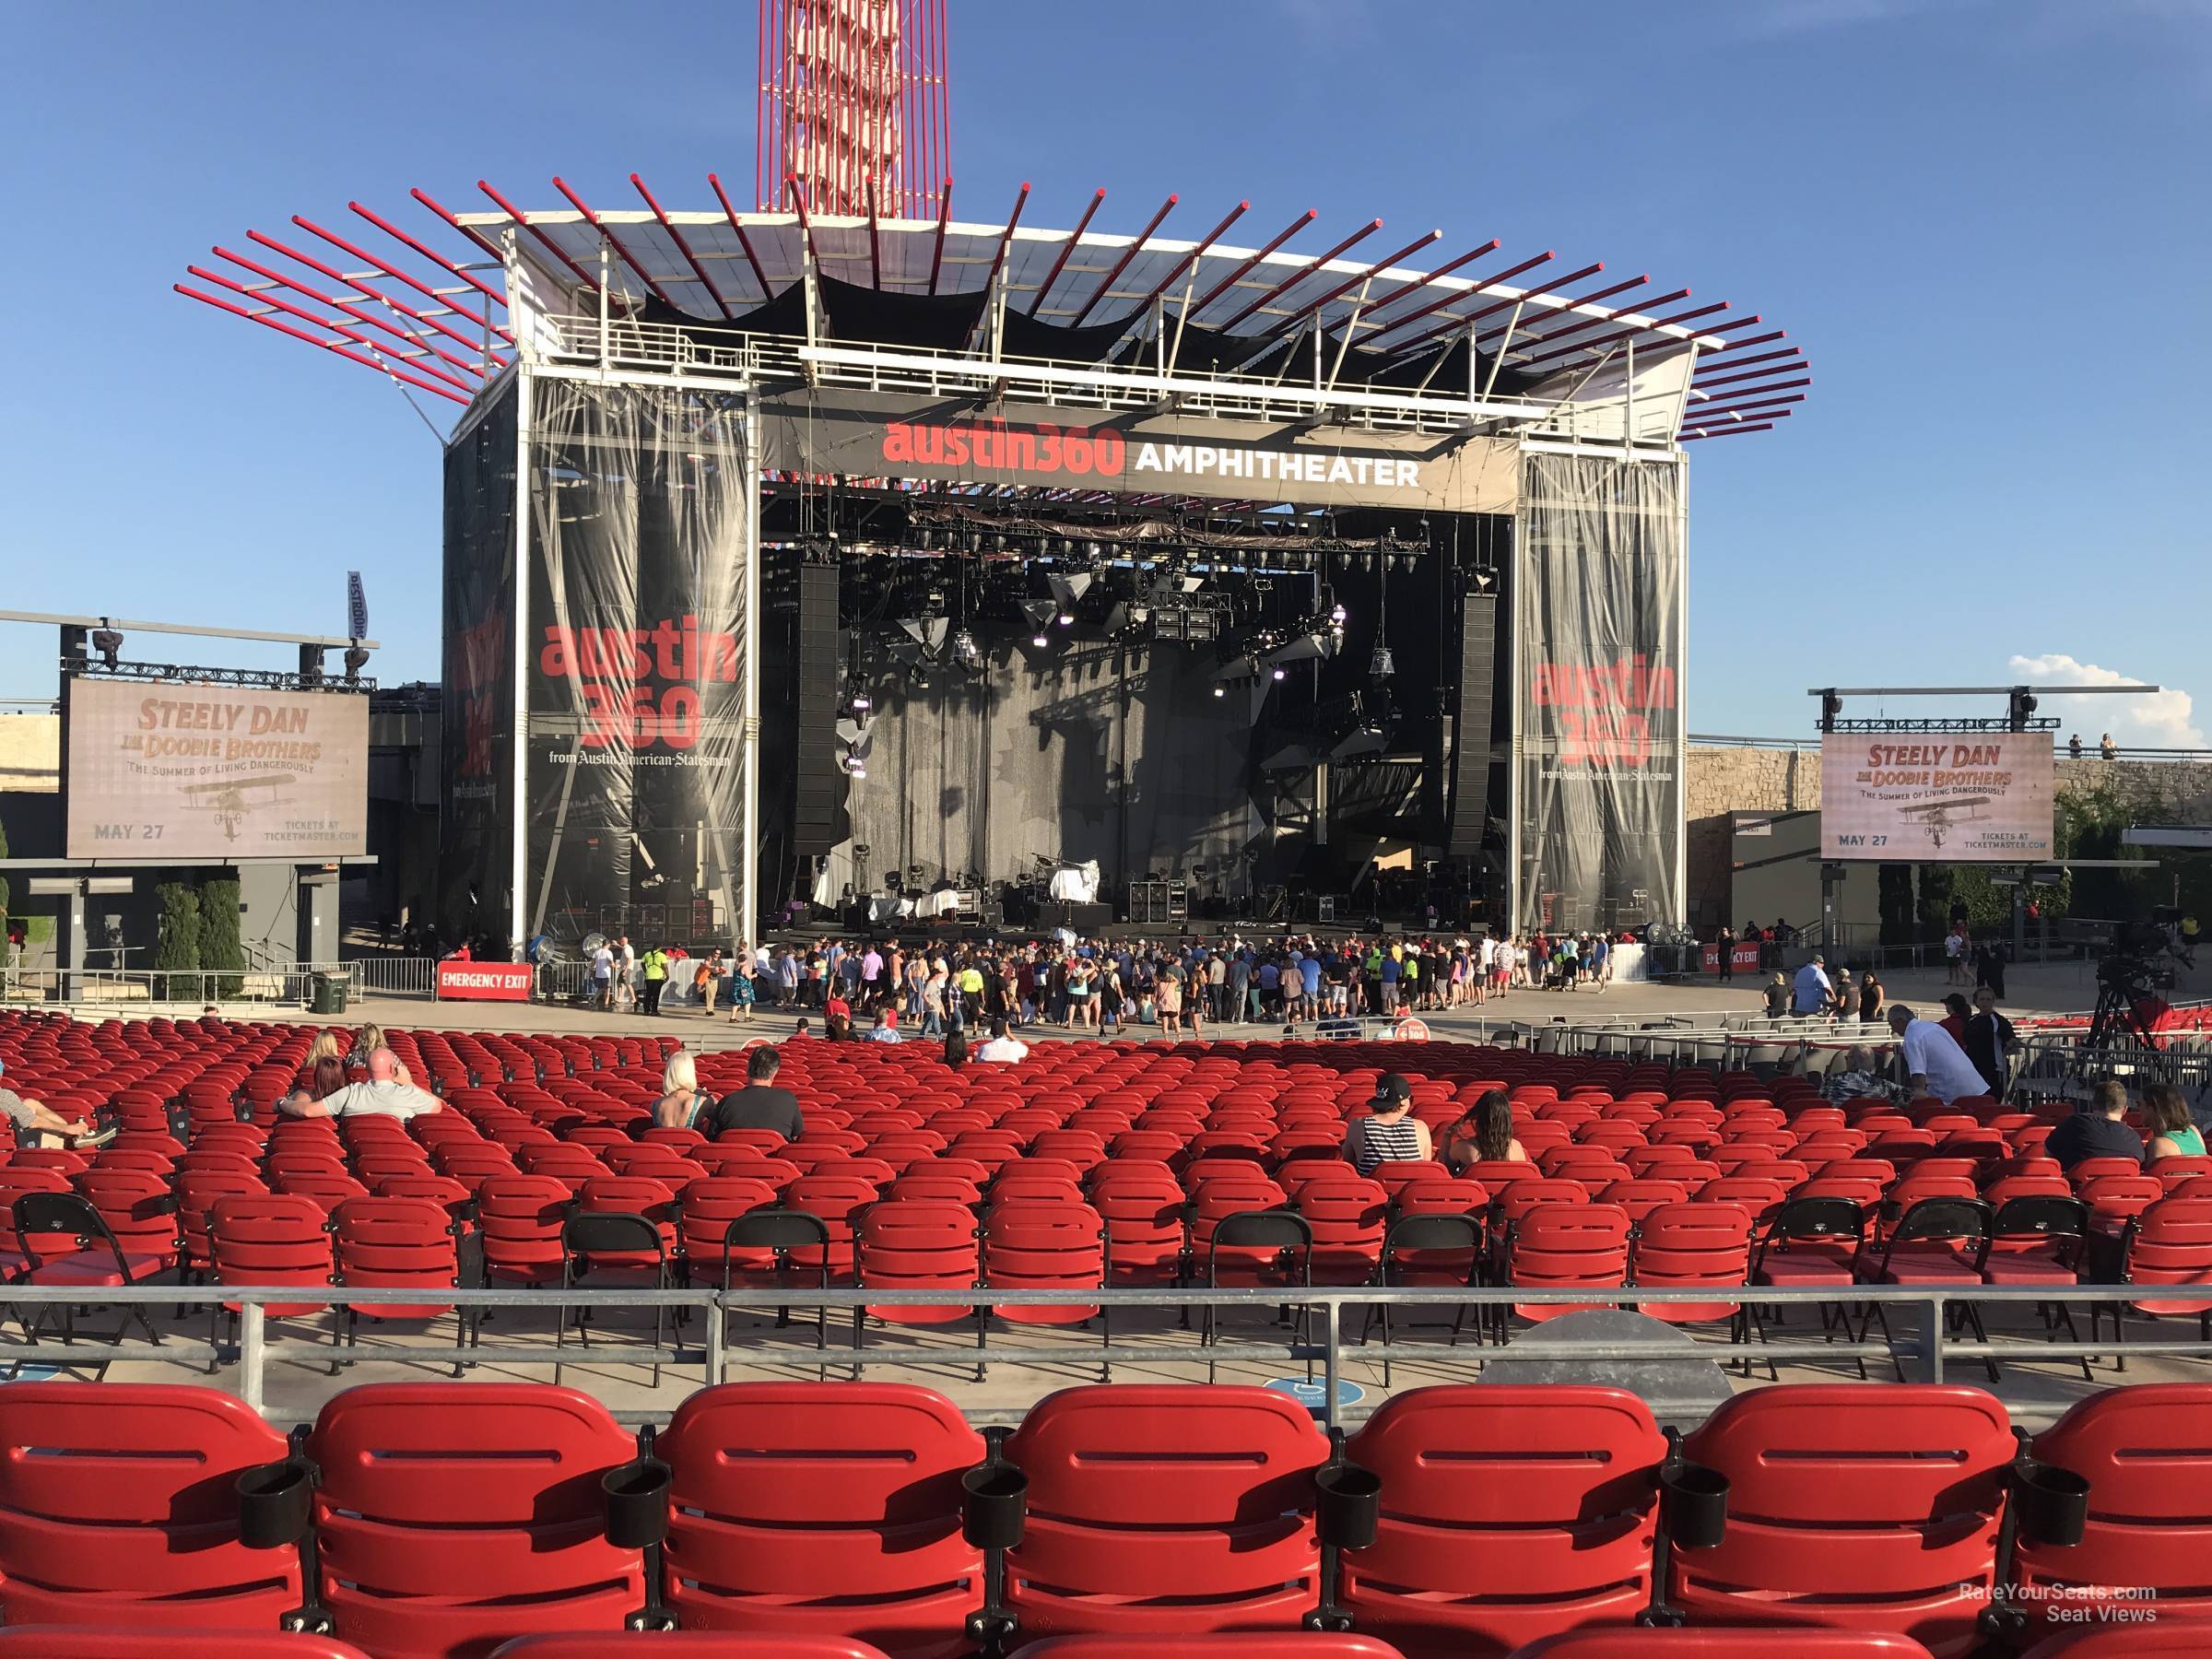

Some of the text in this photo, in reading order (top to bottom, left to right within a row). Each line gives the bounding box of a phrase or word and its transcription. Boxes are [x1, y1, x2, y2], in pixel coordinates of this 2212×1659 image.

[883, 417, 1419, 488] austin360 AMPHITHEATER
[540, 615, 737, 682] austin
[1531, 653, 1675, 709] austin
[138, 698, 310, 735] STEELY DAN
[580, 684, 701, 748] 360
[1561, 711, 1651, 766] 360
[144, 735, 221, 758] DOOBIE
[225, 737, 322, 760] BROTHERS
[1867, 744, 2001, 768] STEELY DAN
[549, 751, 576, 764] from
[577, 750, 616, 766] Austin
[127, 760, 314, 776] THE SUMMER OF LIVING DANGEROUSLY
[1539, 768, 1561, 780] from
[1873, 771, 1929, 788] DOOBIE
[1933, 771, 2013, 788] BROTHERS
[1860, 789, 1877, 799] THE
[1924, 789, 1950, 799] LIVING
[1952, 786, 2006, 796] DANGEROUSLY
[94, 824, 164, 840] MAY 27
[285, 820, 339, 830] TICKETS AT
[265, 832, 359, 841] TICKETMASTER.COM
[1839, 835, 1888, 846] MAY 27
[1745, 951, 1757, 963] EXIT
[442, 972, 527, 989] EMERGENCY EXIT
